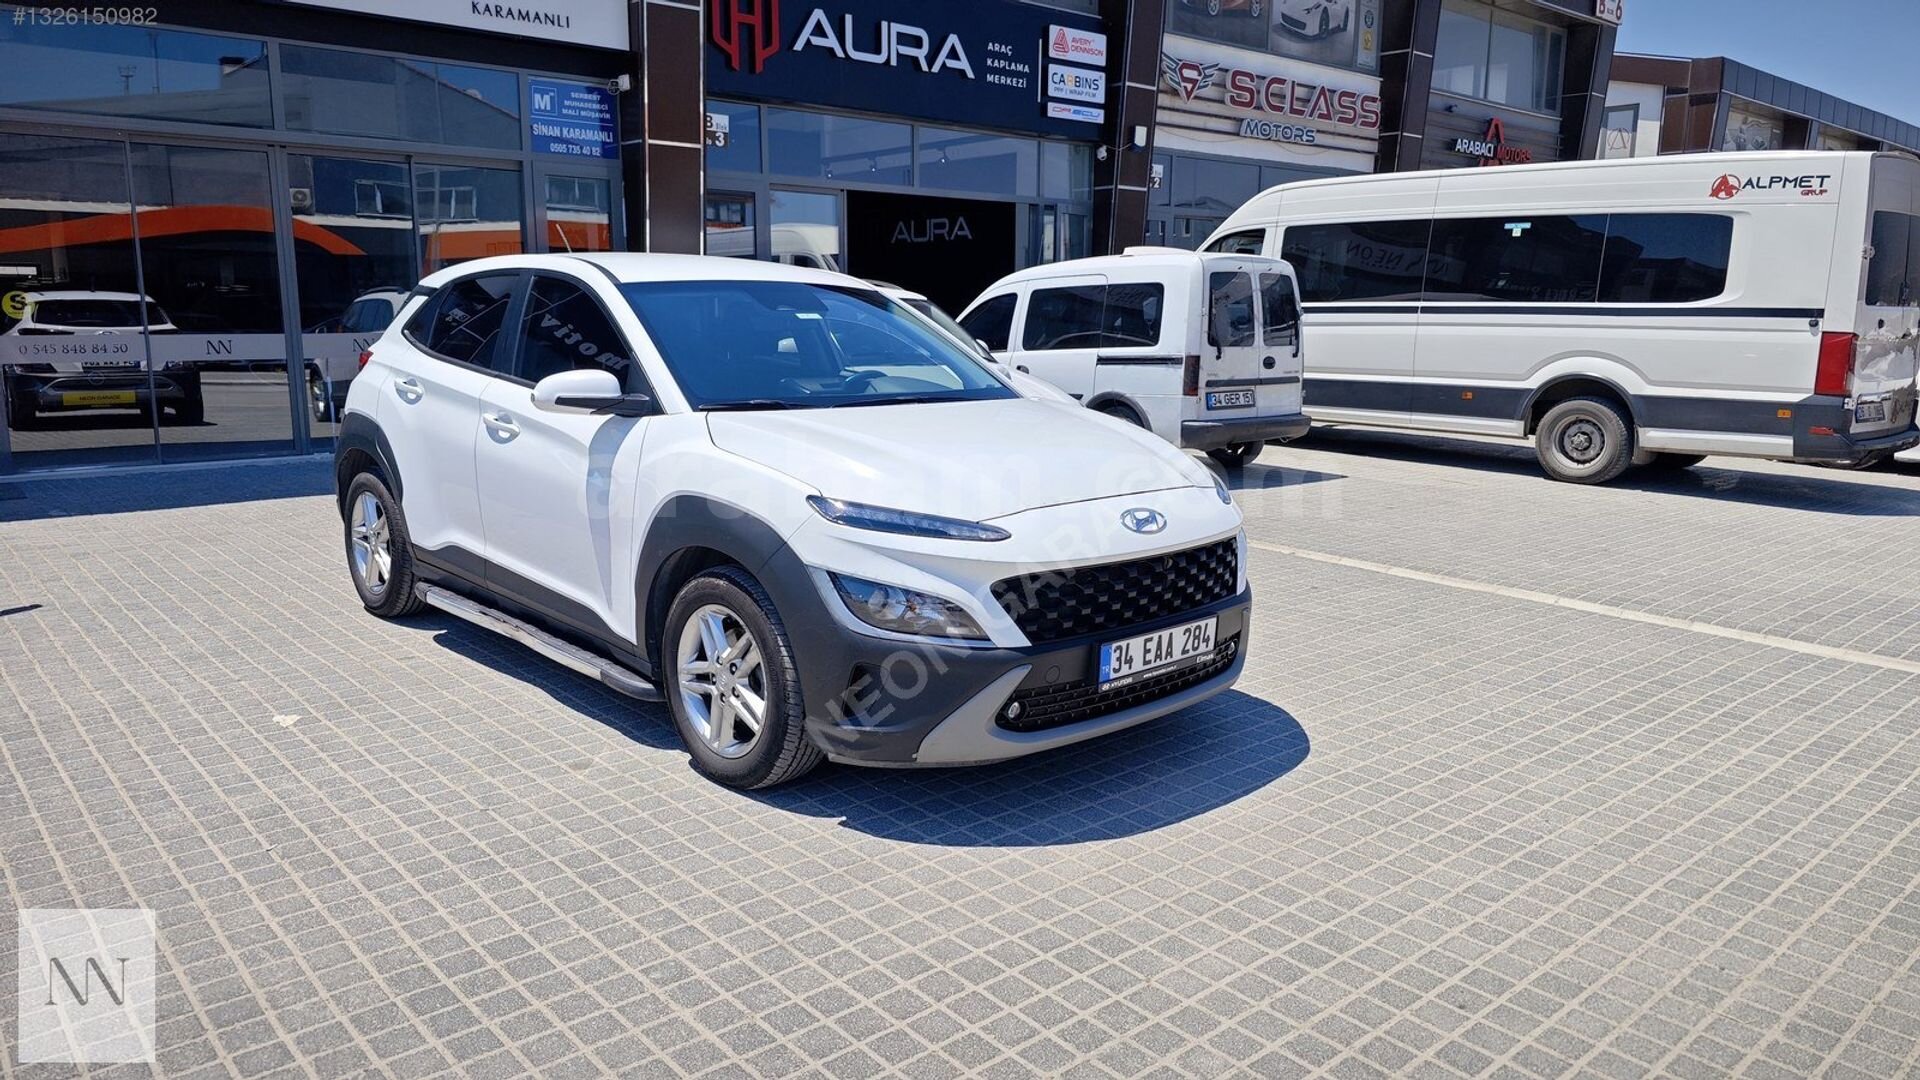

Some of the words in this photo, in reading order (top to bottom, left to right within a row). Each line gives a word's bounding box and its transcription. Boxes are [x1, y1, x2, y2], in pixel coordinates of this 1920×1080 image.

[471, 0, 571, 29] KARAMANLI
[793, 8, 976, 80] AURA
[986, 42, 1013, 56] ARAÇ
[986, 58, 1030, 73] KAPLAMA
[986, 73, 1028, 88] MERKEZİ
[1227, 69, 1258, 110] S
[1263, 75, 1382, 129] CLASS
[532, 121, 560, 138] SİNAN
[562, 126, 614, 143] KARAMANLI
[715, 132, 725, 147] 3
[1242, 119, 1317, 145] MOTORS
[550, 142, 568, 154] 0505
[568, 144, 581, 155] 735
[582, 146, 591, 155] 40
[1455, 138, 1495, 158] ARABACI
[1496, 144, 1533, 162] MOTORS
[1741, 175, 1831, 190] ALPMET
[890, 216, 973, 244] AURA
[32, 343, 57, 355] 545
[61, 343, 87, 355] 848
[91, 343, 107, 354] 84
[1212, 394, 1222, 406] 34
[1224, 392, 1241, 405] GER
[1112, 643, 1134, 674] 34
[1142, 632, 1174, 667] EAA
[1181, 622, 1211, 656] 284
[1101, 665, 1111, 674] TR
